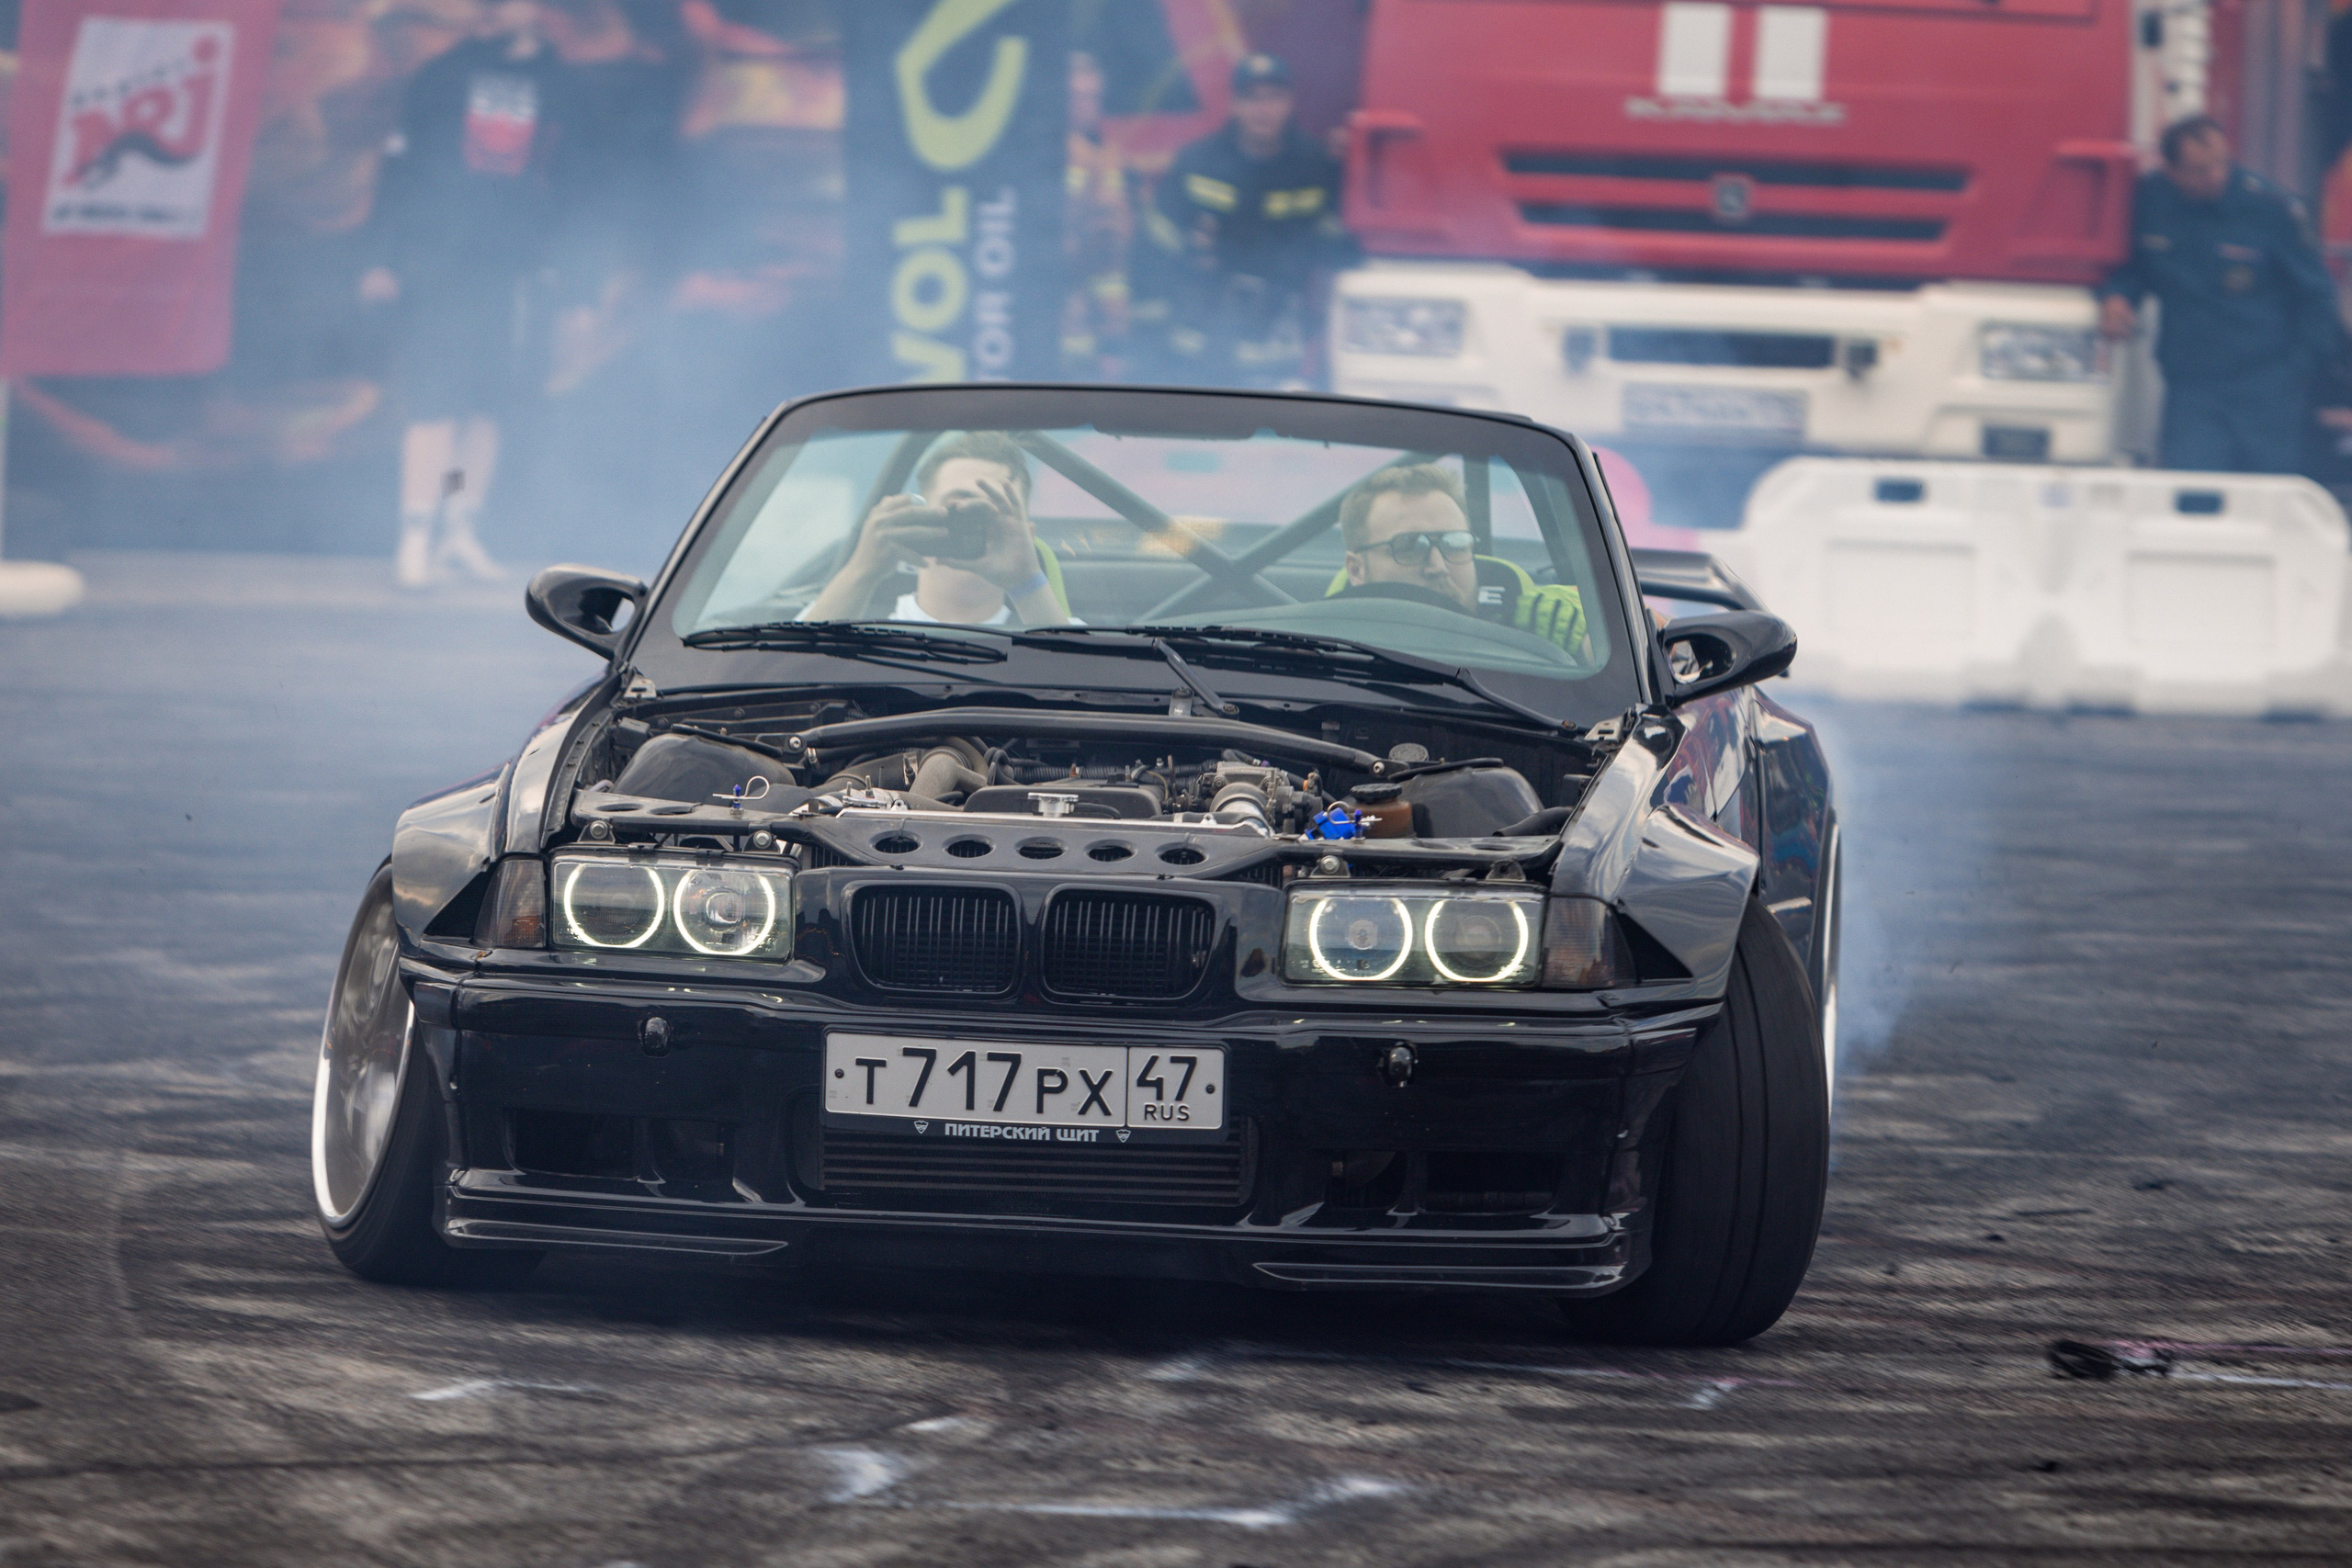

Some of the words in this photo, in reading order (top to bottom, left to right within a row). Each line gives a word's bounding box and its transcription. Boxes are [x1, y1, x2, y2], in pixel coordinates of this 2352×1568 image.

[976, 187, 1016, 277] OIL
[1136, 1055, 1197, 1101] 47
[1144, 1103, 1191, 1122] RUS
[944, 1122, 1051, 1142] ПИТЕРСКИЙ
[1057, 1127, 1100, 1143] ЩИТ
